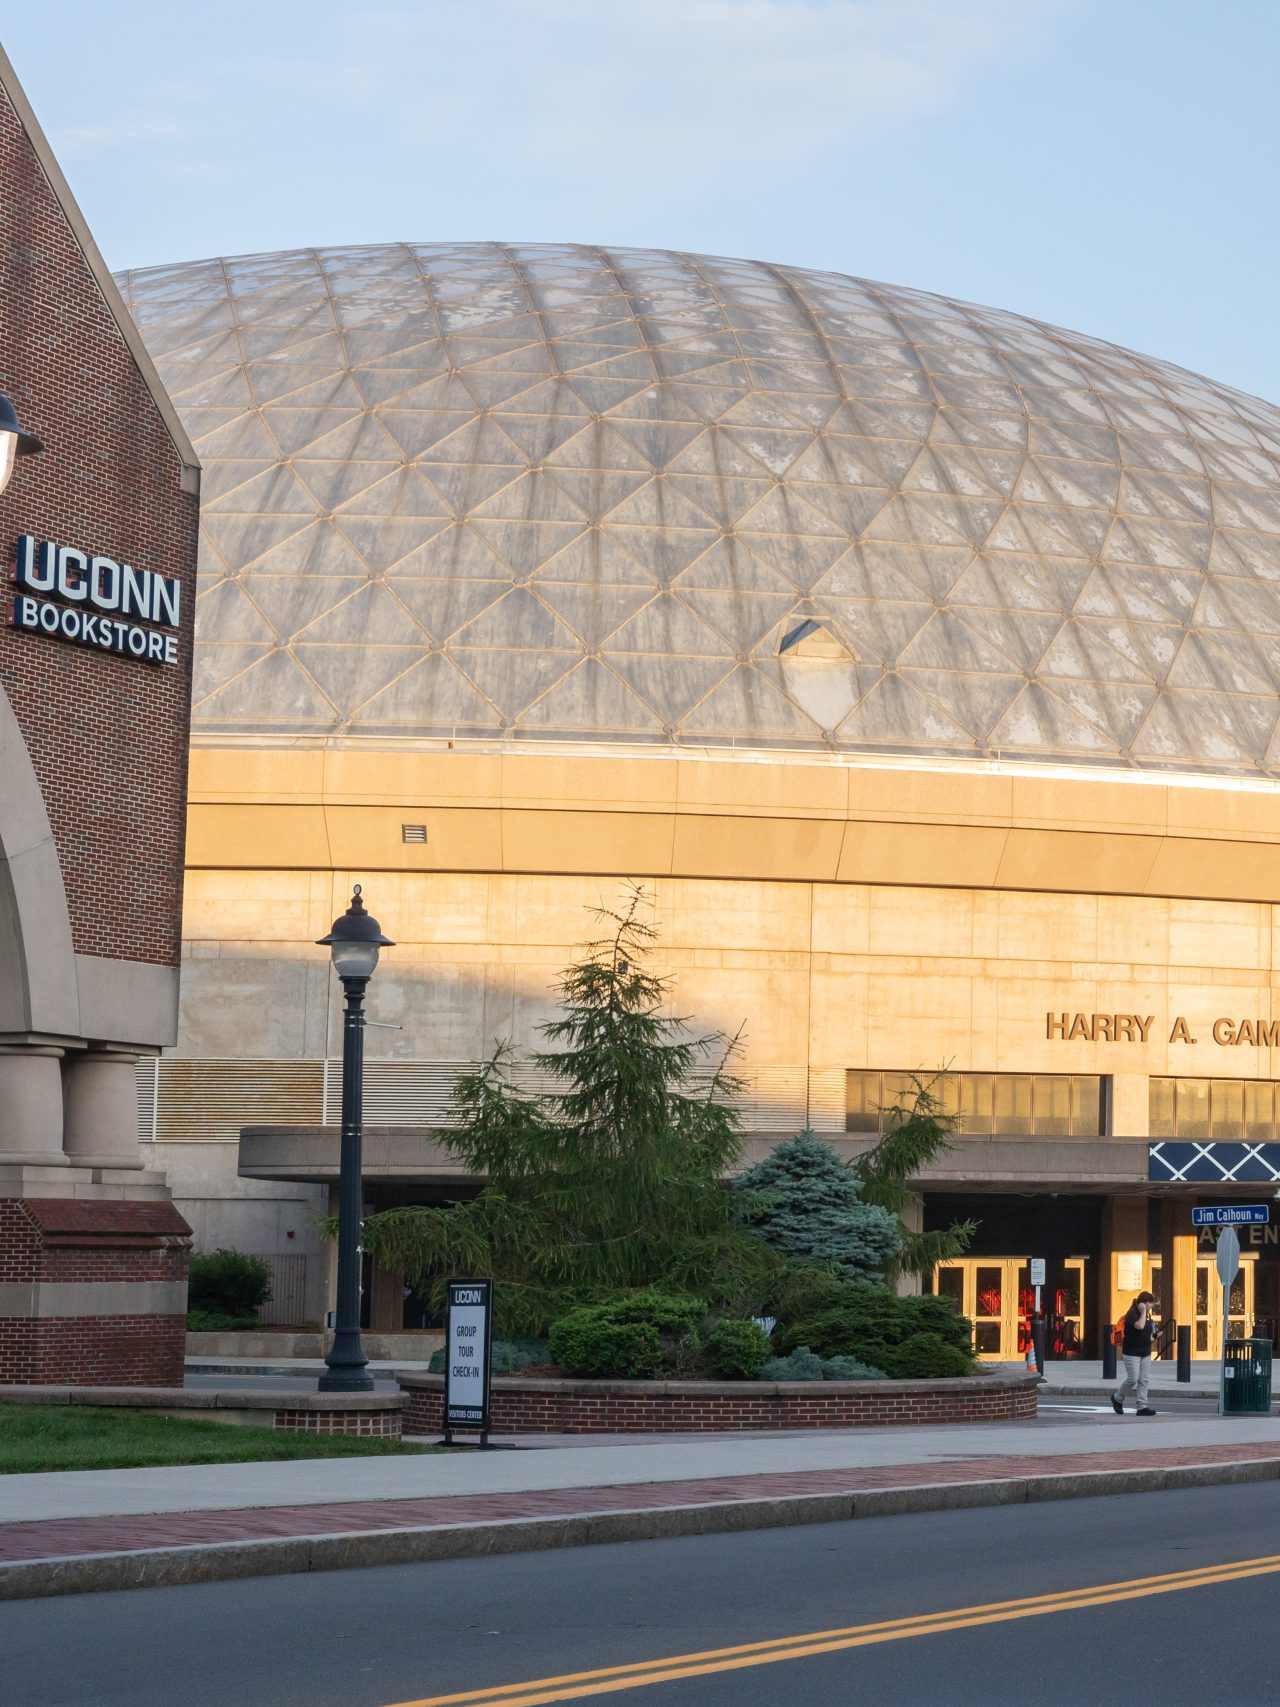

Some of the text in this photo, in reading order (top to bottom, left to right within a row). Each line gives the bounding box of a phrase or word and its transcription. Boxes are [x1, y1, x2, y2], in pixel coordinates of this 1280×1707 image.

[22, 535, 181, 627] UCONN
[20, 596, 179, 664] BOOKSTORE
[1046, 1012, 1155, 1043] HARRY
[1169, 1016, 1198, 1044] A.
[1197, 1209, 1214, 1222] Jim
[1217, 1208, 1252, 1221] Calhoun
[455, 1290, 481, 1303] UCONN
[456, 1326, 477, 1337] GROUP
[458, 1346, 474, 1357] TOUR
[452, 1366, 479, 1378] CHECK-IN
[467, 1411, 482, 1419] CENTER
